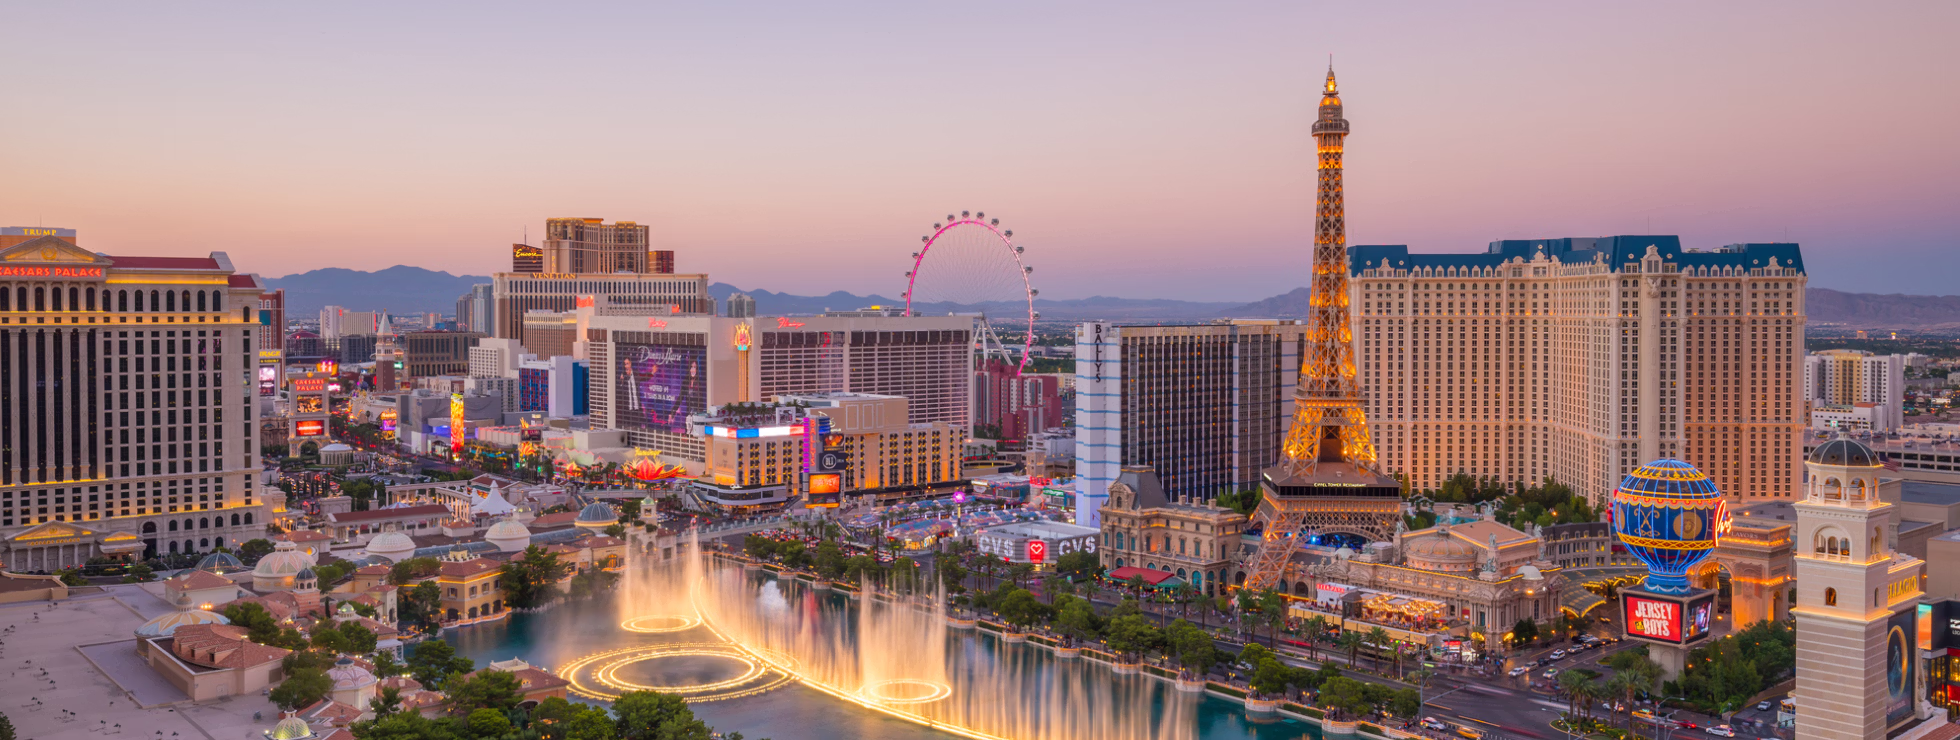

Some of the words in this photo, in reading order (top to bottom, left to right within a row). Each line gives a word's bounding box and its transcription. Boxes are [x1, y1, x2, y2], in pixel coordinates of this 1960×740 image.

[23, 228, 57, 236] TRUMP
[516, 249, 538, 257] Encore
[54, 266, 102, 277] PALACE
[980, 535, 1014, 557] CVS
[1058, 536, 1096, 556] CVS
[1888, 575, 1918, 599] LLAGIO
[1635, 601, 1672, 620] JERSEY
[1643, 618, 1670, 637] BOYS
